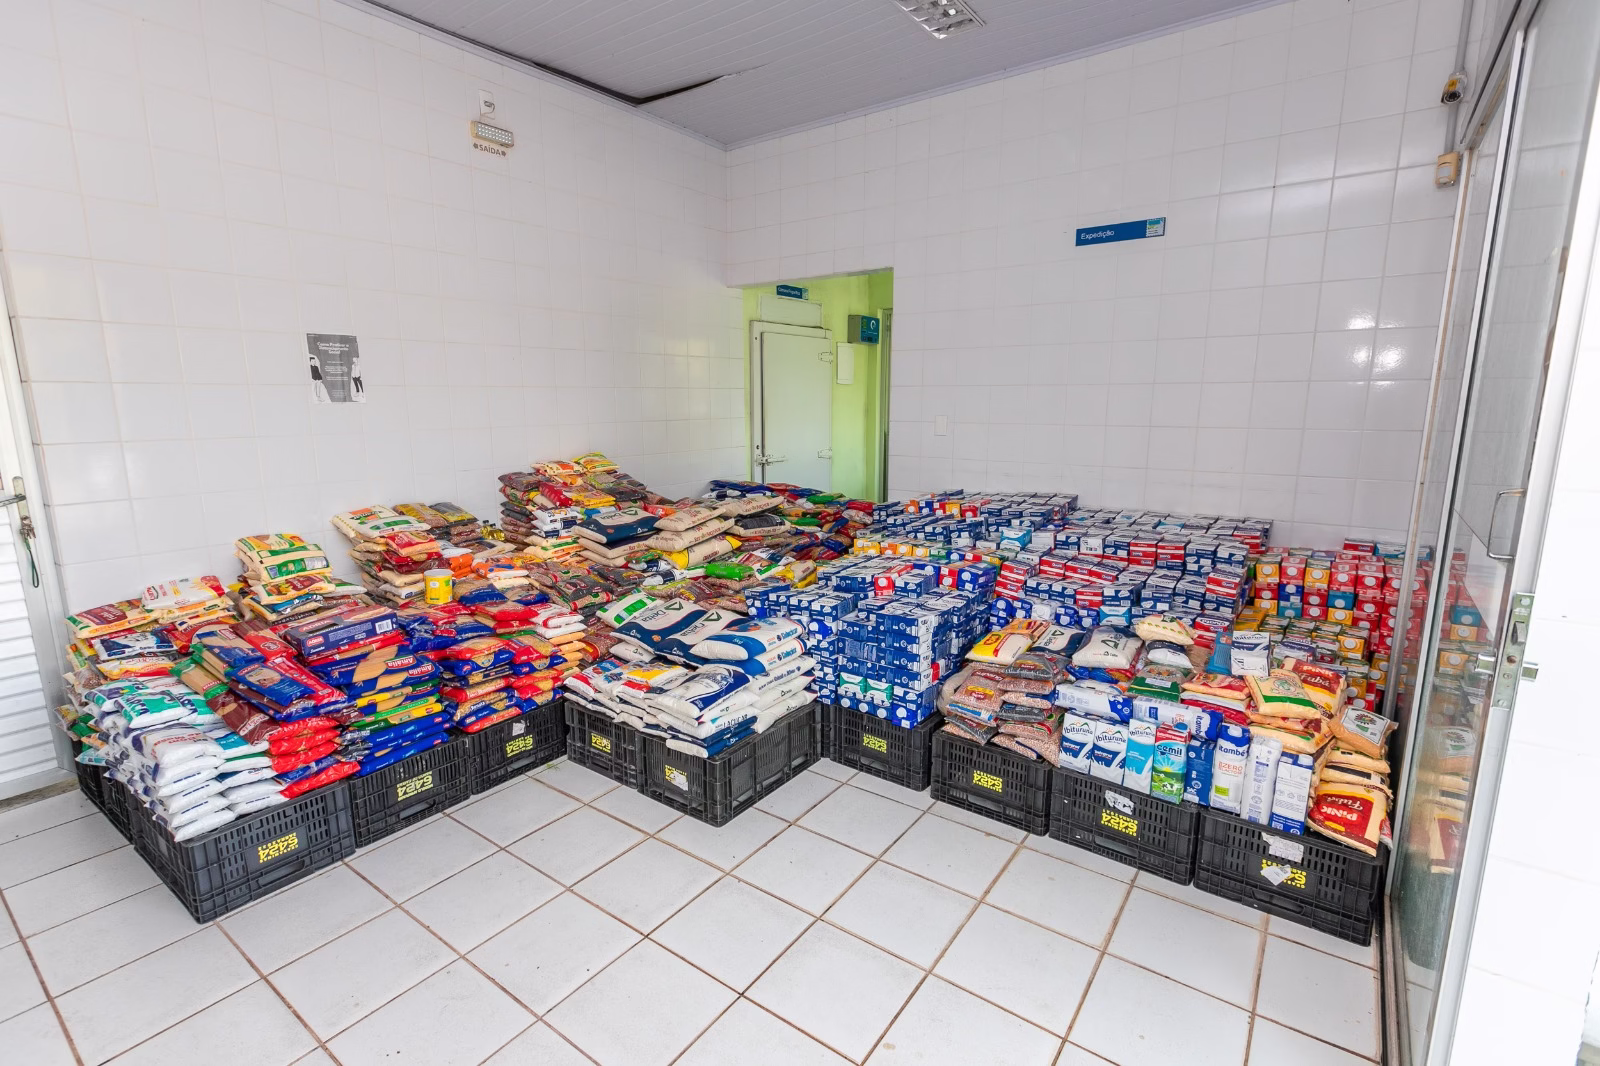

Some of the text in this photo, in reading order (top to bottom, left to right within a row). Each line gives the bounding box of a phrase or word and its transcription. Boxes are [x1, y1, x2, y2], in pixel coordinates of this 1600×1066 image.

[1080, 230, 1115, 240] Expedição
[388, 658, 413, 667] Amália
[408, 664, 432, 676] Amália
[1298, 672, 1330, 687] Fubá
[1064, 726, 1094, 735] Ibituruna
[506, 736, 533, 752] 6424
[863, 736, 887, 749] 6424
[1096, 734, 1127, 744] Ibituruna
[1218, 744, 1246, 757] itambé
[1222, 762, 1244, 771] ZERO
[397, 775, 433, 797] 6424
[973, 773, 1002, 789] 6424
[1102, 813, 1137, 832] 6424
[258, 836, 298, 860] 6424
